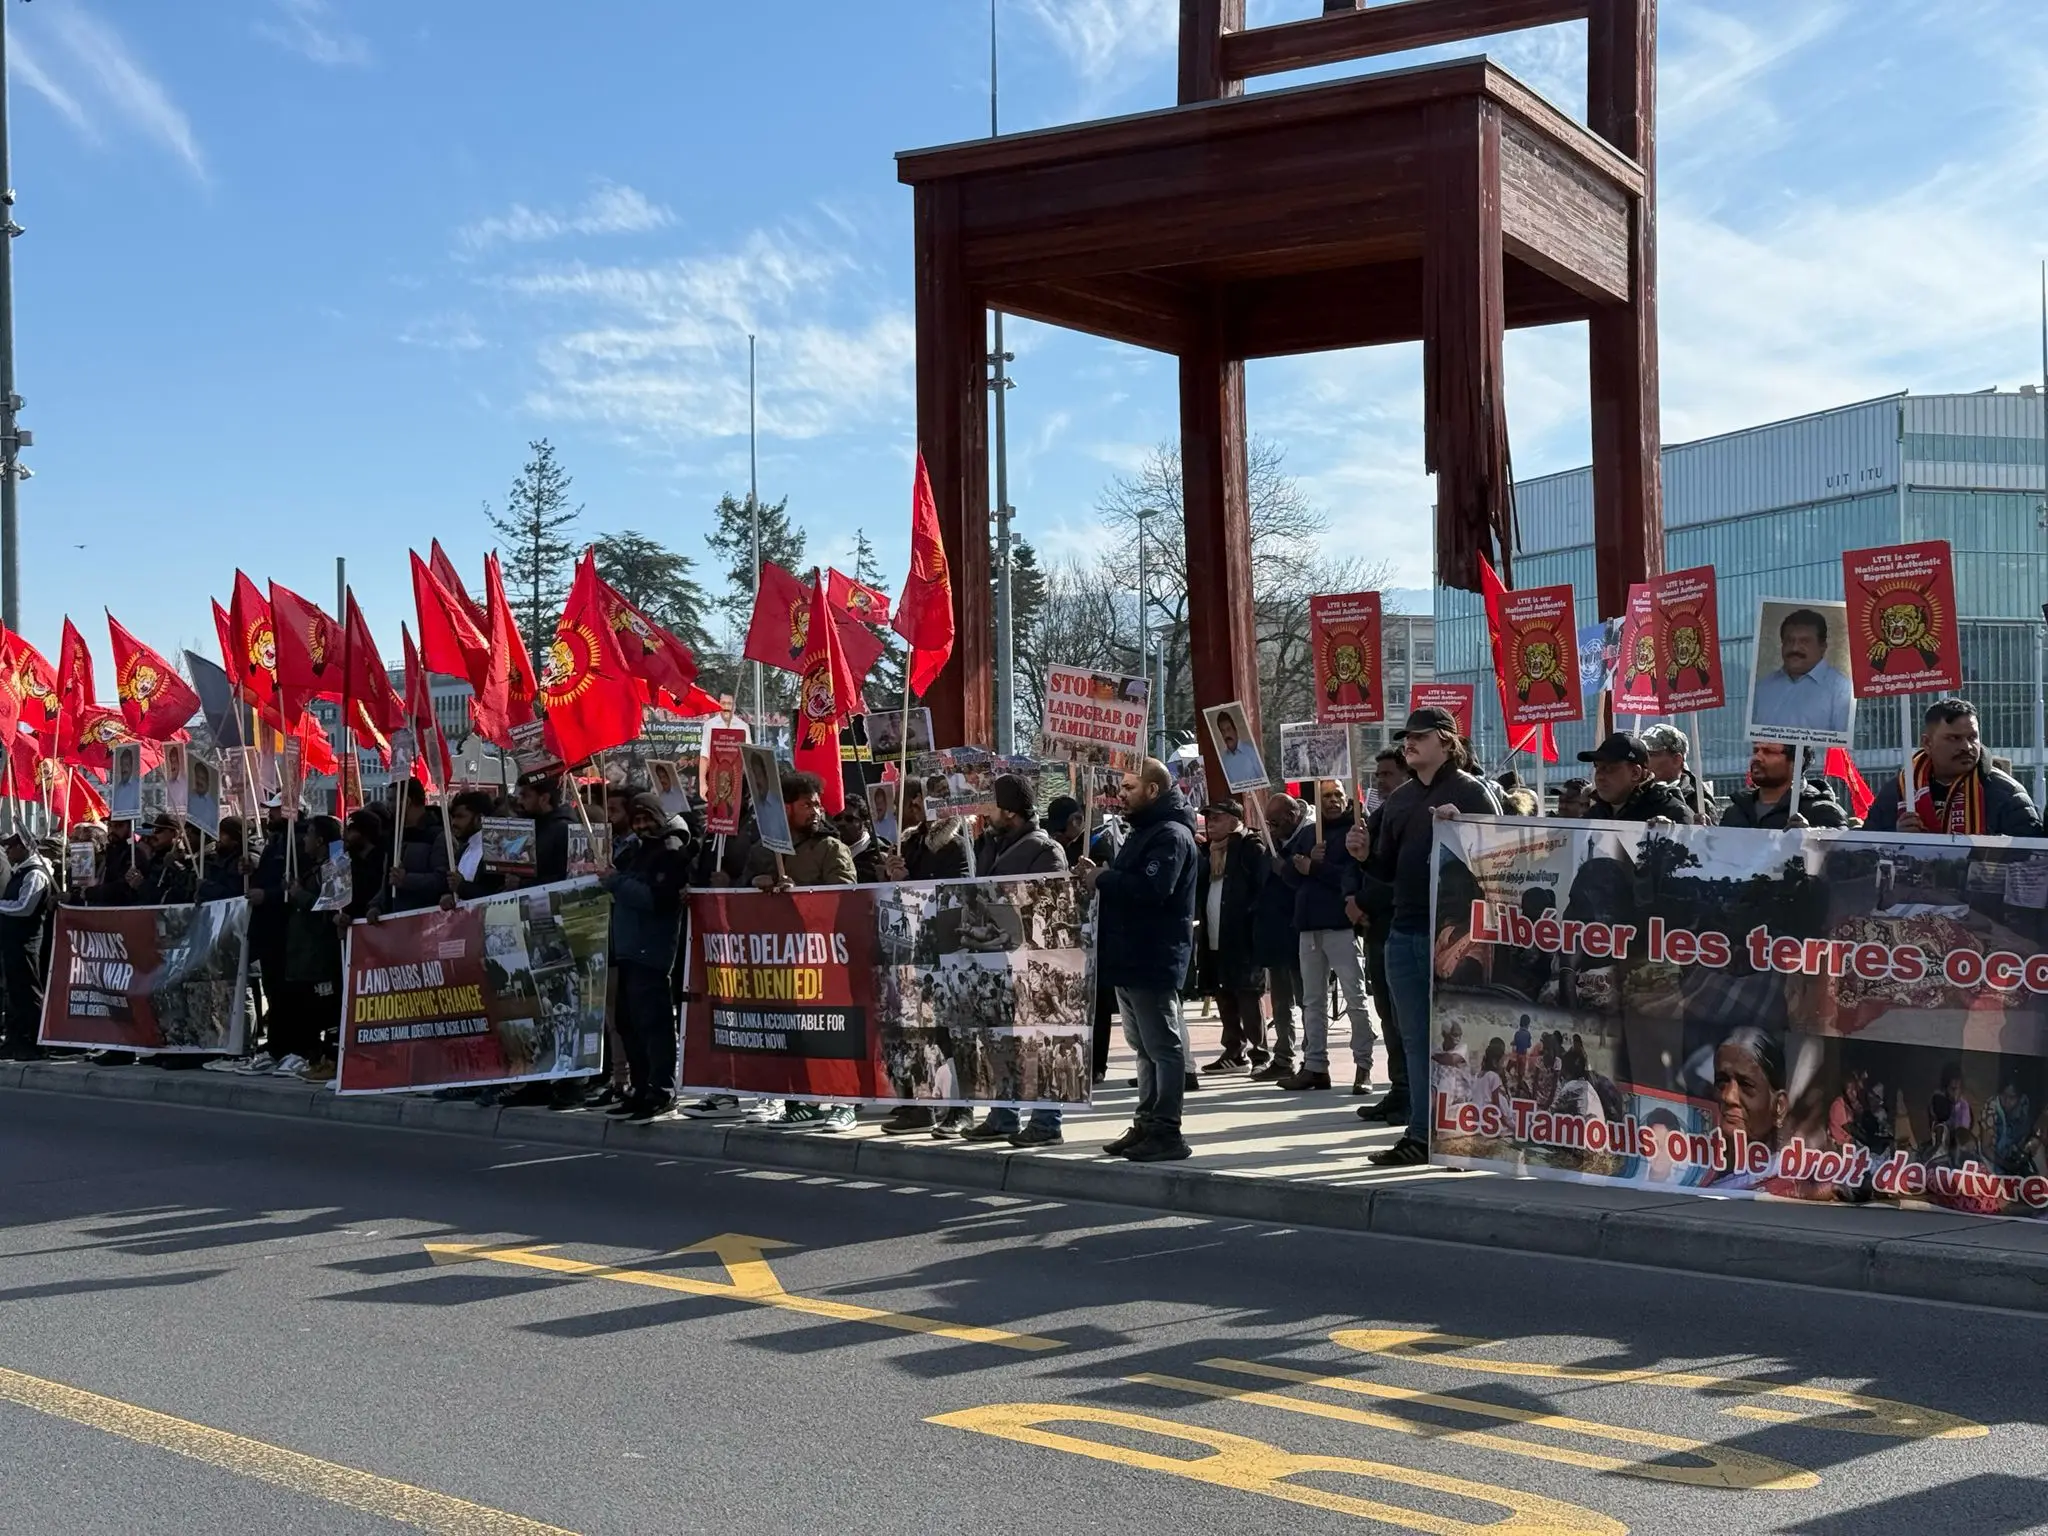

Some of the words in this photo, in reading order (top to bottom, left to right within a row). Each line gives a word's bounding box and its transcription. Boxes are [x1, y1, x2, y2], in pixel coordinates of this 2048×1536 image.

[1826, 473, 1849, 488] UIT
[1861, 467, 1882, 482] ITU
[1855, 564, 1894, 574] National
[1896, 558, 1941, 568] Authentic
[1873, 554, 1892, 563] LTTE
[1864, 569, 1932, 582] Representative
[1048, 699, 1122, 724] LANDGRAB
[1125, 713, 1143, 728] OF
[652, 723, 702, 733] Independent
[1050, 717, 1137, 747] TAMILEELAM
[750, 933, 827, 964] DELAYED
[830, 932, 849, 965] IS
[1470, 900, 1636, 960] Libérer
[1648, 916, 1732, 968] les
[1746, 924, 1927, 982] terres
[102, 962, 133, 990] WAR
[357, 968, 390, 995] LAND
[389, 964, 422, 991] GRABS
[422, 960, 444, 986] AND
[752, 968, 823, 1000] DENIED!
[355, 990, 438, 1023] DEMOGRAPHIC
[438, 984, 485, 1014] CHANGE
[358, 1027, 390, 1043] ERASING
[391, 1025, 410, 1040] TAMIL
[739, 1012, 762, 1028] LANKA
[764, 1014, 824, 1031] ACCOUNTABLE
[827, 1015, 845, 1031] FOR
[730, 1031, 764, 1048] GENOCIDE
[1435, 1092, 1501, 1138] Les
[1510, 1098, 1656, 1159] Tamouls
[1666, 1127, 1726, 1171] ont
[1733, 1129, 1771, 1174] le
[1779, 1137, 1870, 1187] droit
[1872, 1150, 1926, 1196] de
[1936, 1160, 2048, 1208] vivre
